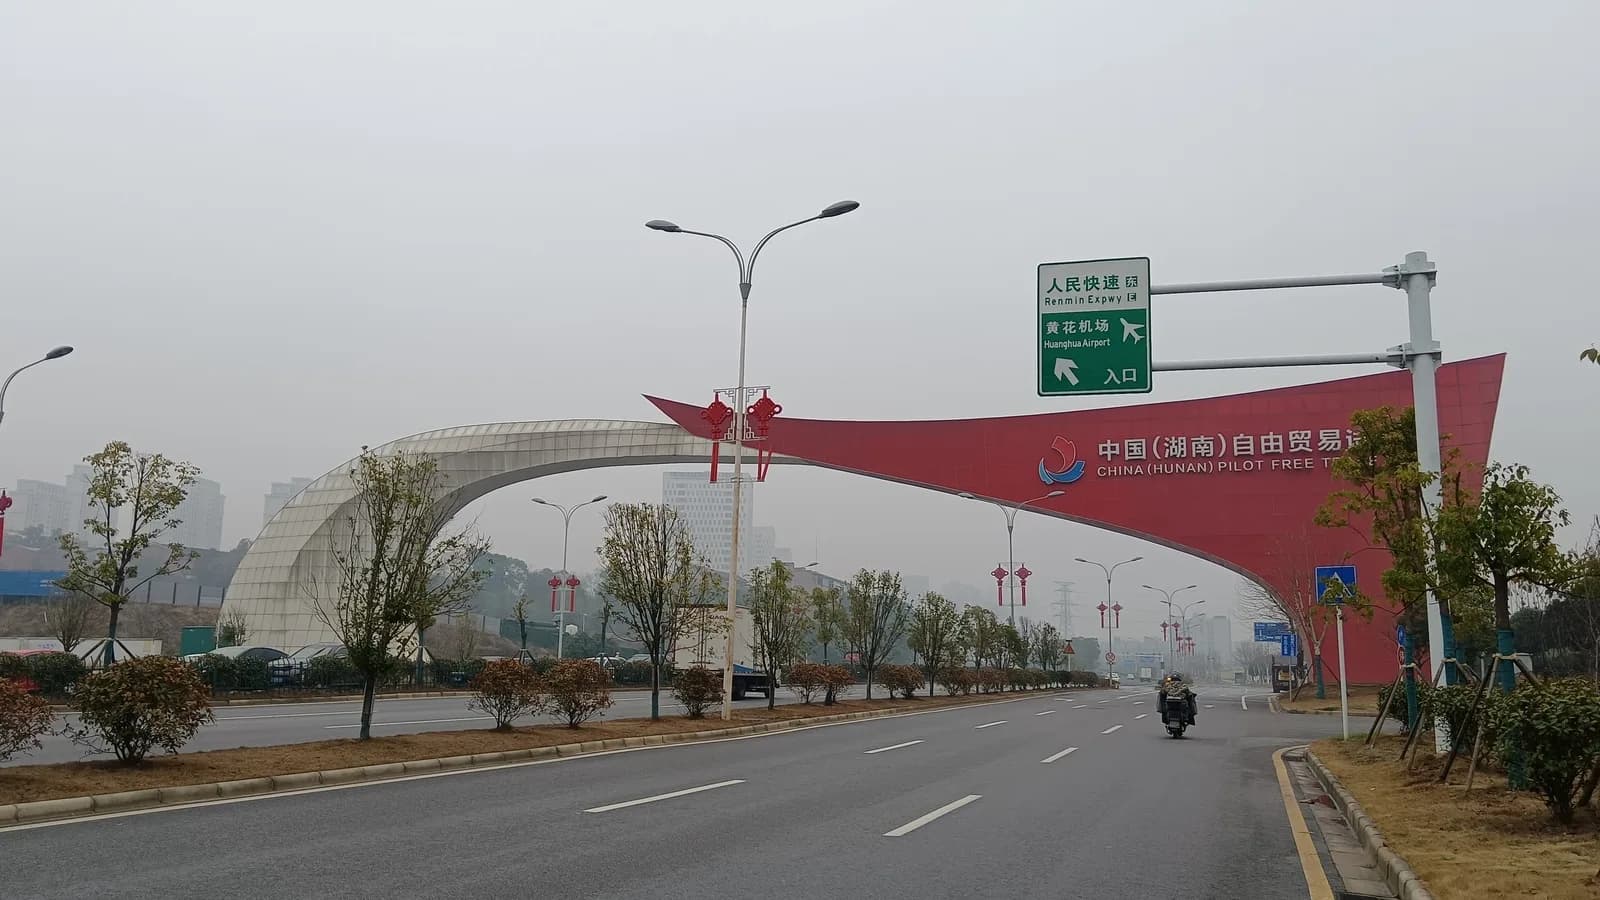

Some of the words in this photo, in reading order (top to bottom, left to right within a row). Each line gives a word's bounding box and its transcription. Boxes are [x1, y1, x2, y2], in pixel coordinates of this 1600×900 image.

[1047, 275, 1120, 293] 人民快速
[1045, 297, 1085, 306] Renmin
[1088, 295, 1122, 305] Expwy
[1046, 319, 1109, 335] 黄花机场
[1044, 339, 1082, 350] Huanghua
[1082, 338, 1111, 348] Airport
[1104, 368, 1137, 384] 入口
[1097, 465, 1144, 477] CHINA
[1147, 461, 1213, 475] (HUNAN)
[1218, 460, 1264, 472] PILOT
[1272, 458, 1315, 470] FREE
